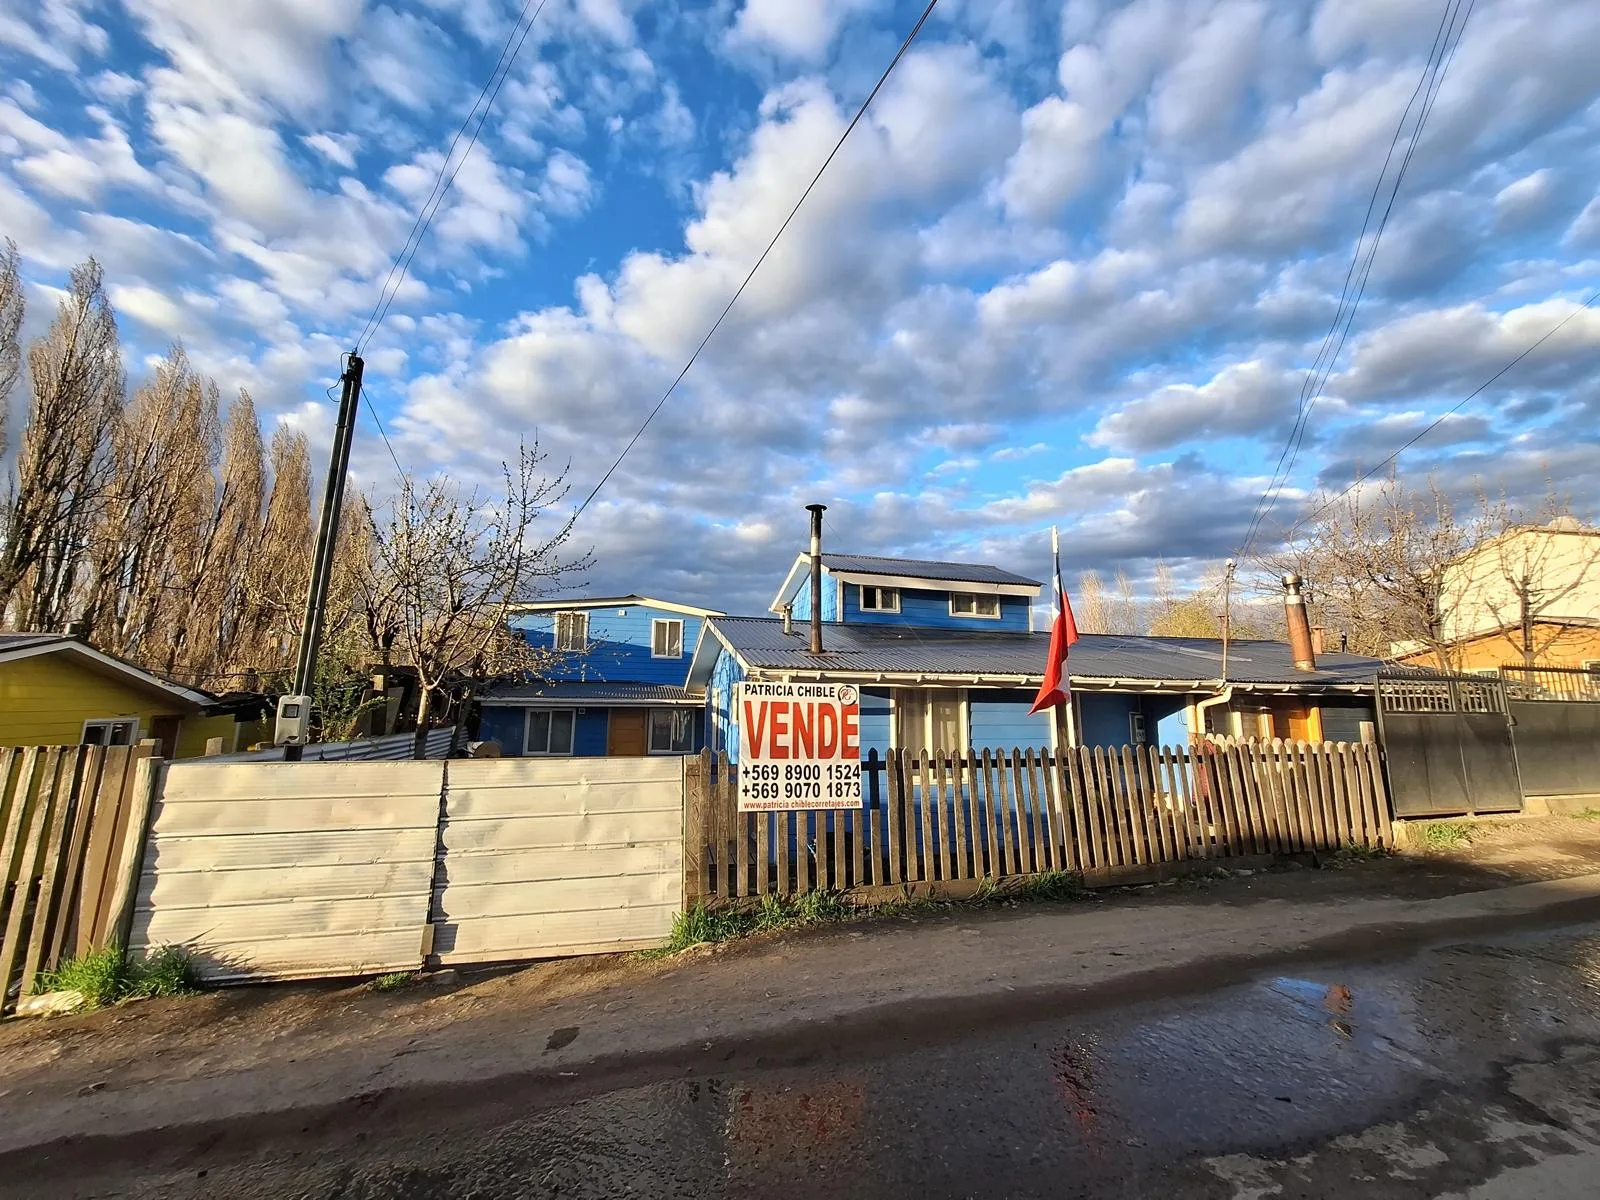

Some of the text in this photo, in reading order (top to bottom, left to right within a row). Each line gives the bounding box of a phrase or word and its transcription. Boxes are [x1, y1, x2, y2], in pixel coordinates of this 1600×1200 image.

[744, 684, 794, 697] PATRICIA
[797, 685, 835, 698] CHIBLE
[743, 700, 860, 760] VENDE
[742, 764, 861, 781] +569 8900 1524
[742, 782, 861, 799] +569 9070 1873
[743, 799, 860, 810] www.patricia chiblecorretajes.com
